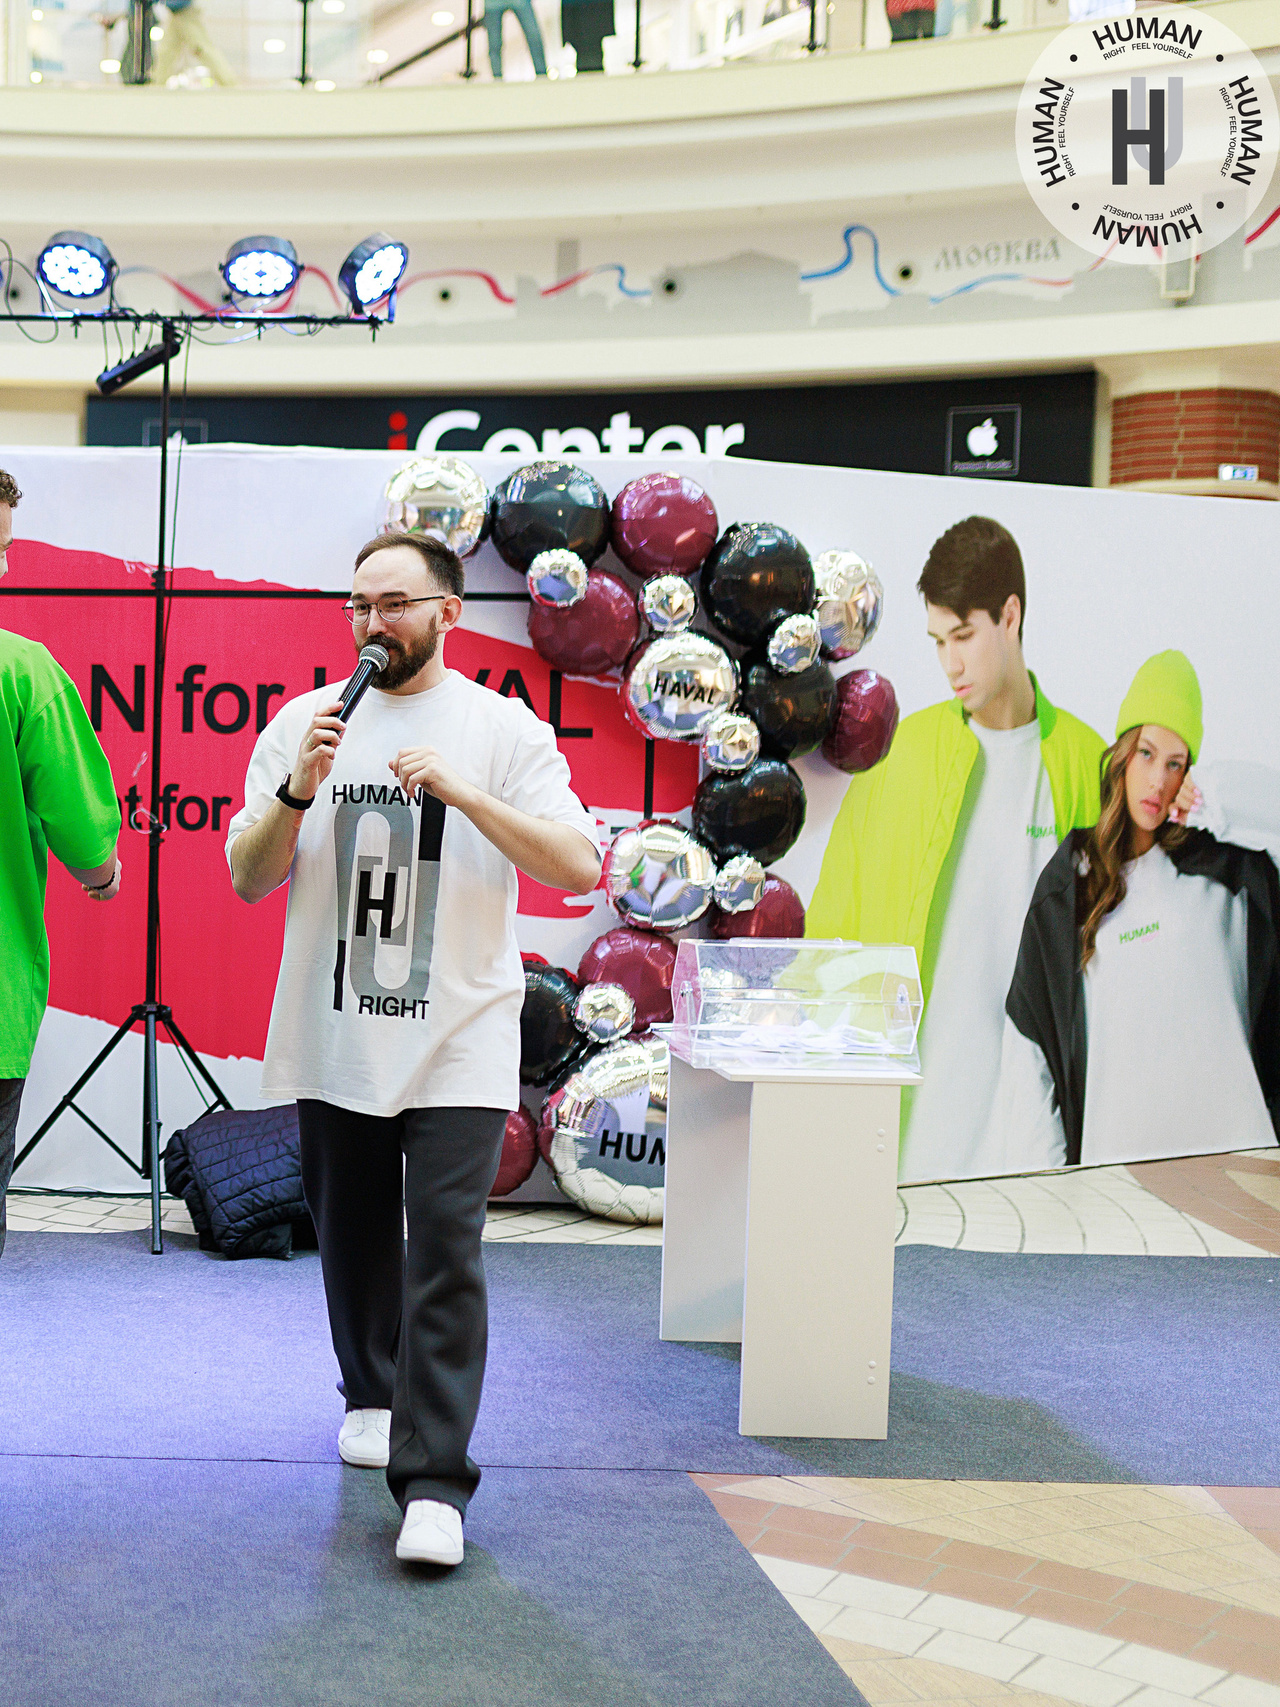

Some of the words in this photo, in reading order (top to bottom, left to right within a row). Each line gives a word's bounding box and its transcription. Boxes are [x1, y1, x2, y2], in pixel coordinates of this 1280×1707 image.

[175, 664, 286, 734] for
[654, 672, 714, 704] HAVAL
[159, 784, 232, 831] for
[332, 784, 422, 807] HUMAN
[1026, 824, 1058, 838] HUMA
[1119, 921, 1159, 944] HUMAN
[358, 994, 430, 1020] RIGHT
[599, 1129, 666, 1166] HUM
